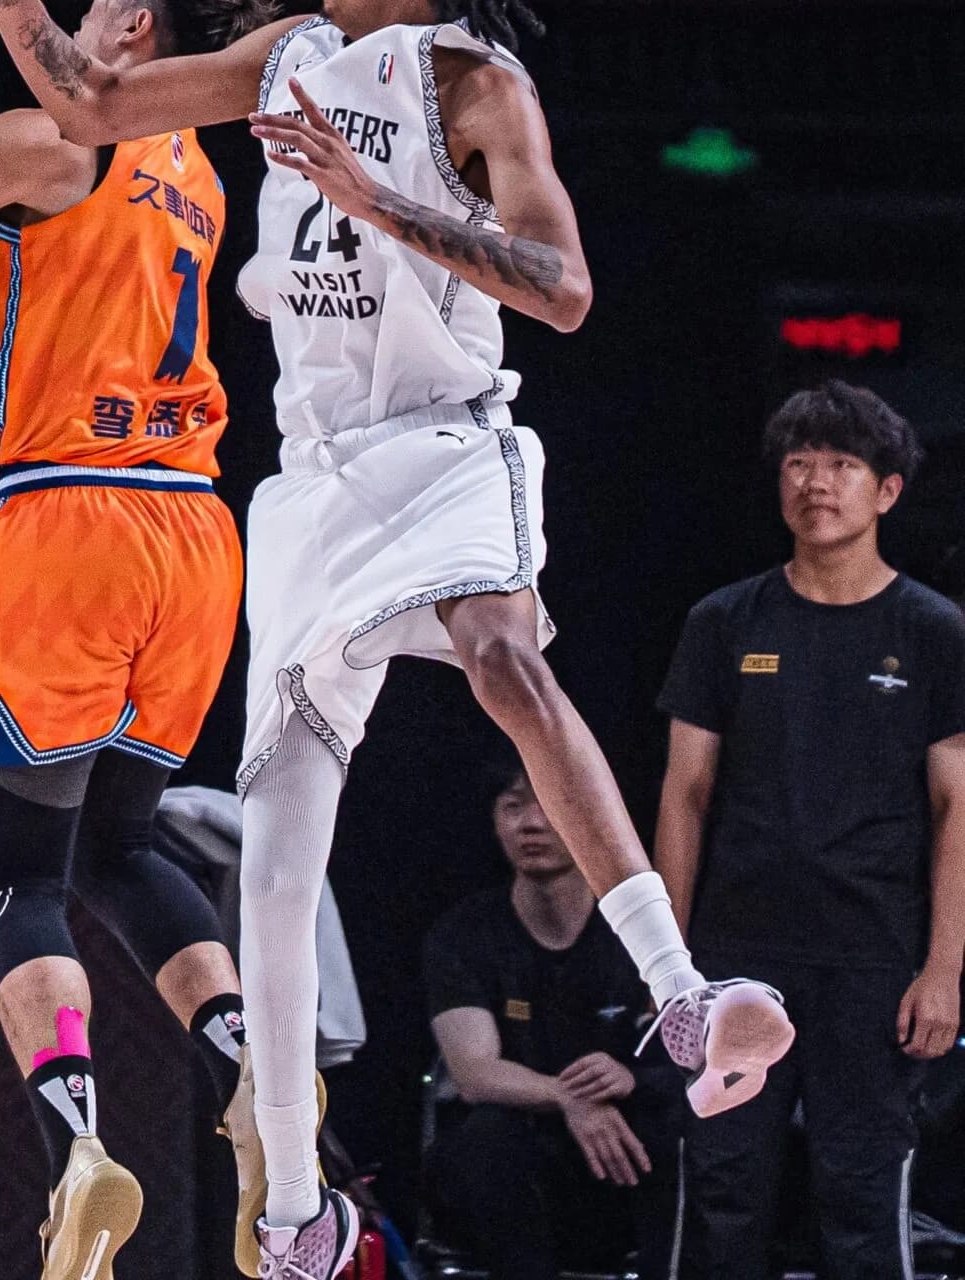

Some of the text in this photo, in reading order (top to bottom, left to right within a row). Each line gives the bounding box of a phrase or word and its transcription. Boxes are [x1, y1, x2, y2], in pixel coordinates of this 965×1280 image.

[290, 178, 362, 263] 24
[278, 291, 386, 320] WAND
[291, 269, 362, 294] VISIT
[153, 246, 203, 386] 1
